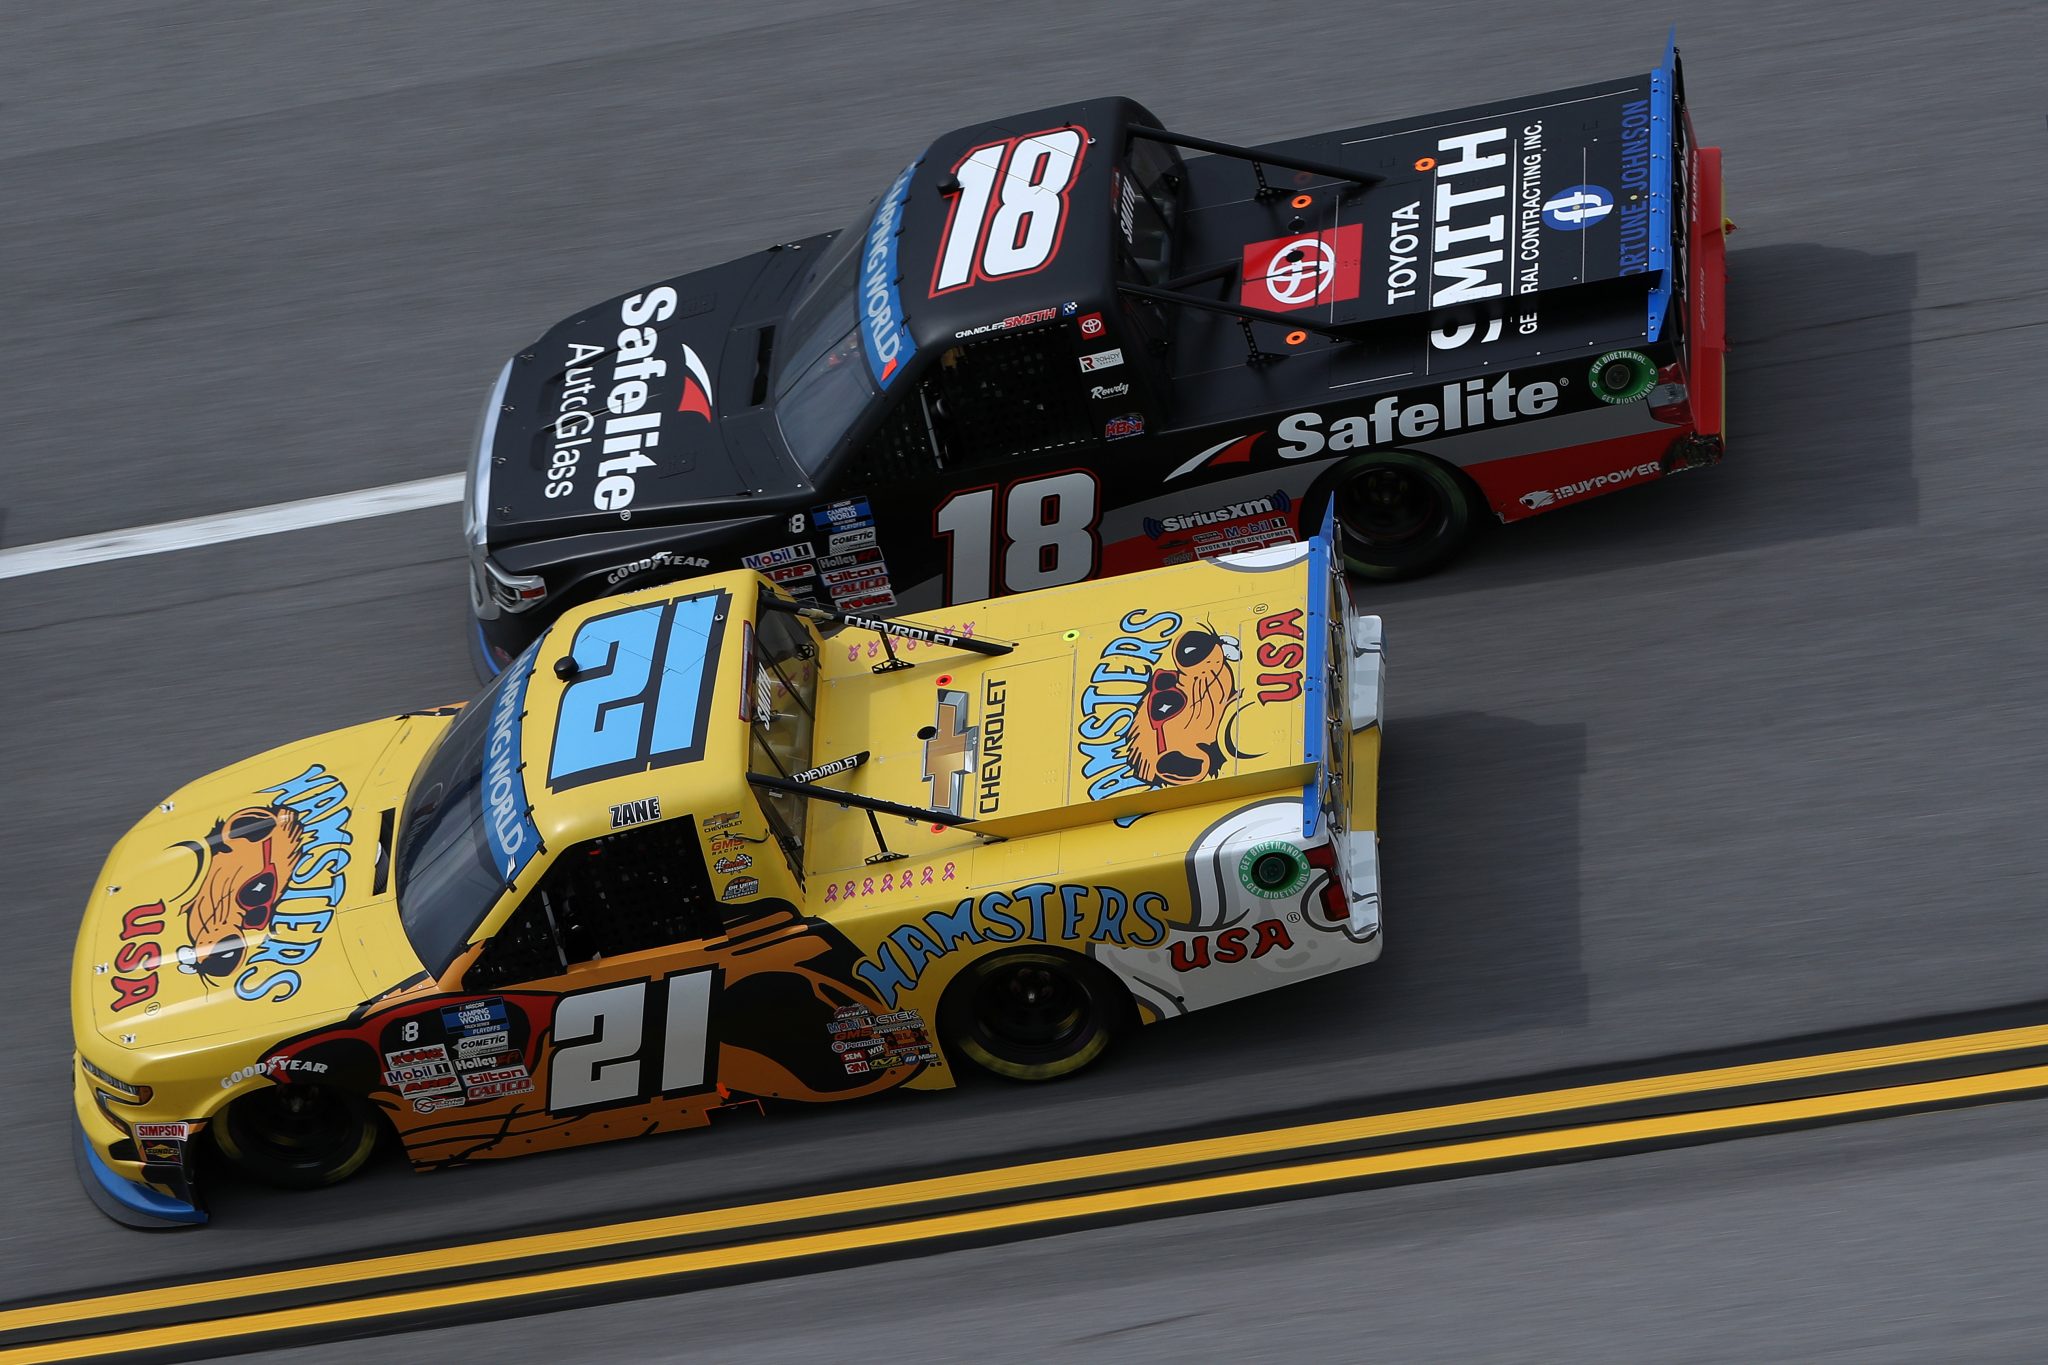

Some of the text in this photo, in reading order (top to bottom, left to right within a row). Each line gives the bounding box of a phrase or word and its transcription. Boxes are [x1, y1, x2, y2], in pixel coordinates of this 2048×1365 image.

[1621, 100, 1649, 191] JOHNSON
[930, 126, 1087, 297] 18
[1519, 120, 1542, 334] GERAL CONTRACTING INC.
[1388, 202, 1420, 305] TOYOTA
[955, 308, 1056, 339] CHANDLER SMITH
[1592, 351, 1647, 374] GET BIOETHANOL
[594, 286, 678, 511] Safelite
[1091, 382, 1129, 400] Rowdy
[1602, 394, 1615, 404] GET
[545, 343, 604, 498] AutoGlass
[1276, 371, 1560, 459] Safelite
[1555, 461, 1661, 500] iBUYPOWER
[827, 505, 856, 516] CAMPING
[828, 511, 857, 523] WORLD
[791, 513, 805, 533] 8
[1224, 520, 1270, 538] Mobil
[832, 531, 873, 545] COMETIC
[935, 469, 1098, 605] 18
[1197, 542, 1221, 553] TOYOTA
[1222, 538, 1246, 549] RACING
[1247, 530, 1292, 544] DEVELOPMENT
[607, 551, 711, 584] GOODYEAR
[746, 548, 791, 568] Mobil
[819, 555, 857, 569] Holley
[844, 615, 958, 647] CHEVROLET
[1257, 608, 1303, 707] USA
[547, 591, 728, 789] 21
[1078, 608, 1182, 828] AMSTERS
[979, 678, 1006, 814] CHEVROLET
[793, 755, 859, 784] CHEVROLET
[609, 796, 662, 830] ZANE
[704, 820, 743, 833] CHEVROLET
[712, 838, 744, 852] GMS
[712, 845, 745, 856] RACING
[1240, 841, 1302, 871] GET BIOETHANOL
[234, 764, 353, 1002] HAMSTERS
[1246, 872, 1309, 899] GET BIOETHANOL
[111, 899, 166, 1012] USA
[855, 883, 1170, 1008] HAMSTERS
[1166, 920, 1294, 973] USA
[458, 1007, 490, 1018] CAMPING
[459, 1014, 491, 1026] WORLD
[876, 1009, 919, 1024] CTEK
[405, 1021, 419, 1042] 8
[472, 1025, 501, 1035] PLAYOFFS
[548, 967, 716, 1113] 21
[461, 1035, 506, 1049] COMETIC
[868, 1045, 885, 1055] WIX
[456, 1055, 497, 1071] Holley
[844, 1052, 862, 1061] SEM
[846, 1062, 869, 1073] 3M
[220, 1055, 328, 1089] GOODYEAR
[388, 1066, 432, 1083] Mobil
[467, 1069, 524, 1084] tilton
[139, 1125, 185, 1137] SIMPSON
